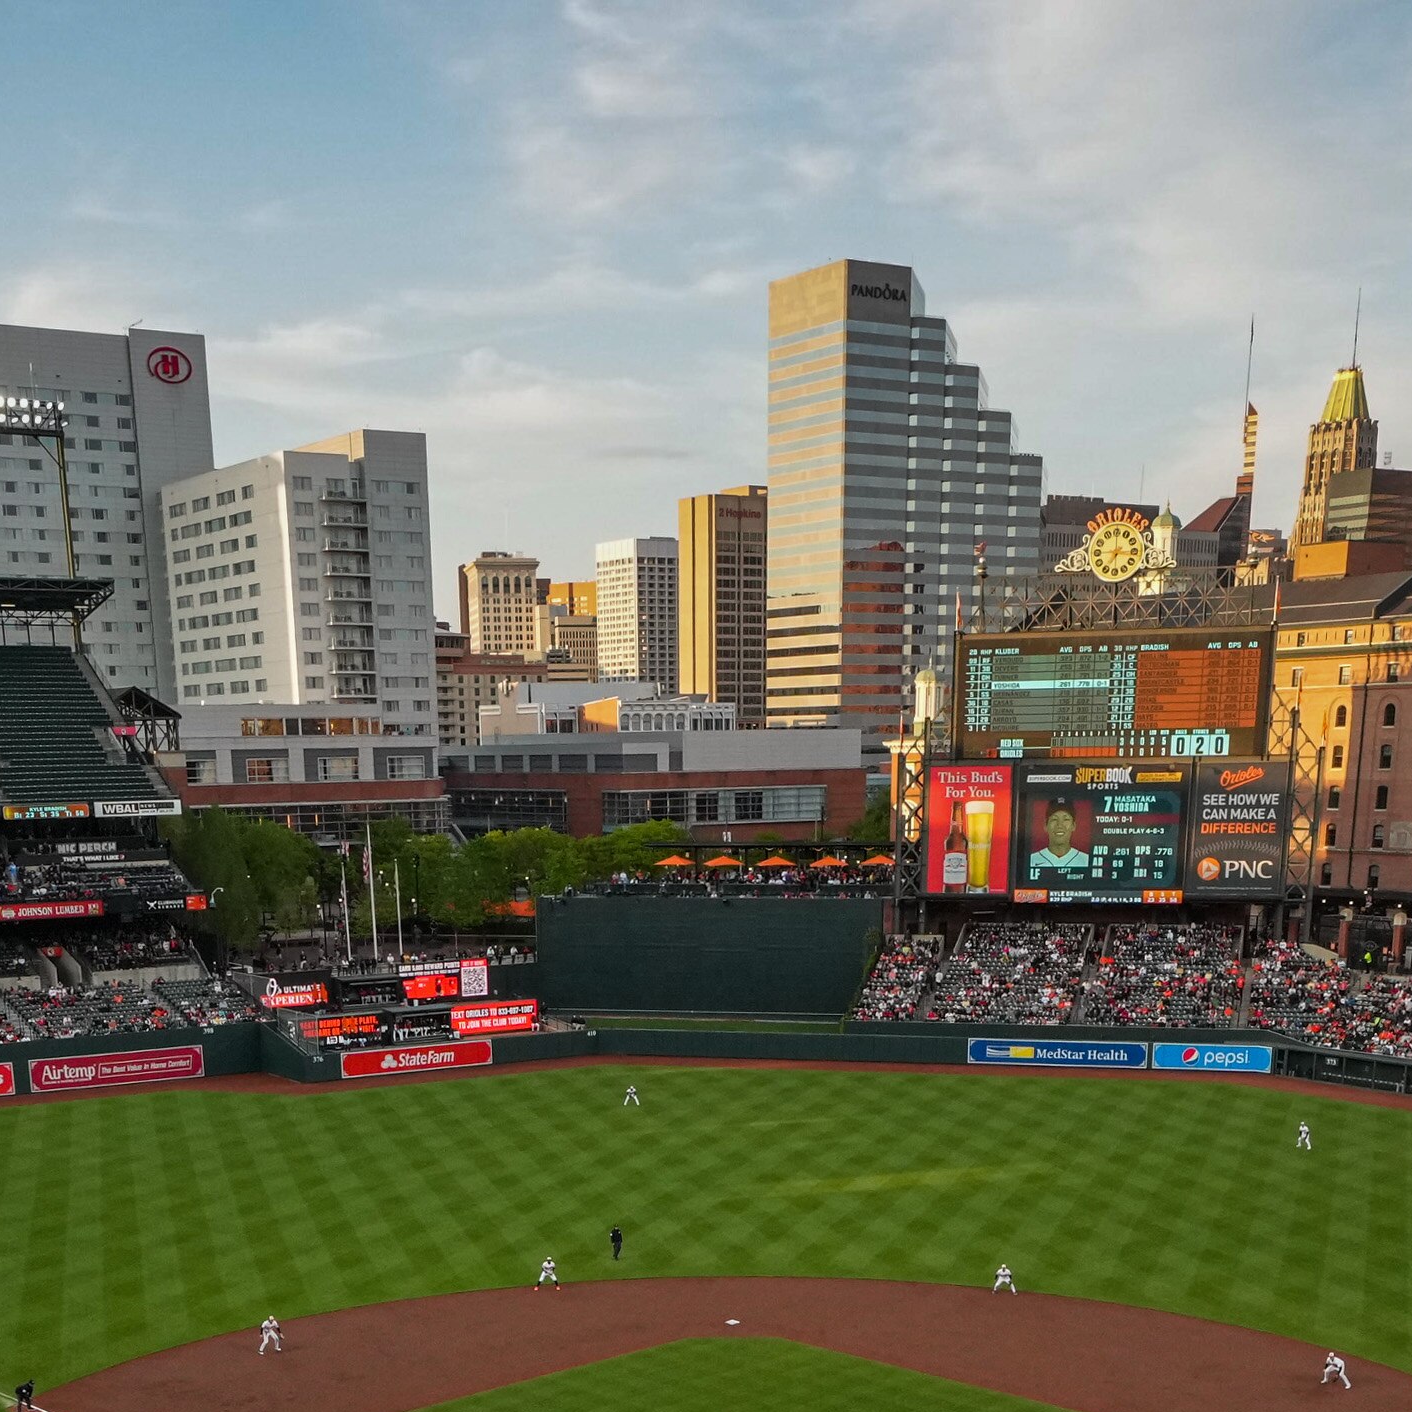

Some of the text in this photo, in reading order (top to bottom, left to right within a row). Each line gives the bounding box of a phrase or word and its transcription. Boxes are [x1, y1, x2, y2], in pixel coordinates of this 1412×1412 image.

[1087, 507, 1149, 533] ORIOLES
[1060, 646, 1073, 654] AVG
[1141, 641, 1221, 651] BRADISH AVG
[1175, 735, 1224, 755] 0 2 0
[1000, 750, 1023, 758] ORIOLES
[938, 770, 1003, 783] This Bud's
[1075, 766, 1133, 784] SUPERBOOK
[1220, 766, 1265, 790] Orioles
[945, 785, 995, 797] For You.
[1104, 795, 1156, 812] 7 MASATAKA
[1202, 793, 1280, 805] SEE HOW WE
[101, 803, 138, 815] WBAL
[1114, 803, 1149, 812] YOSHIDA
[1202, 808, 1276, 820] CAN MAKE A
[1200, 822, 1276, 834] DIFFERENCE
[78, 842, 117, 853] PERCH
[1093, 845, 1108, 855] AVG
[1135, 845, 1151, 855] OPS
[1030, 869, 1040, 880] LF
[1223, 860, 1273, 879] PNC
[17, 905, 85, 917] JOHNSON LUMBER
[444, 961, 460, 969] POINTS
[451, 1008, 489, 1019] TEXT ORIOLES
[458, 1016, 527, 1029] TO JOIN THE CLUB TODAY!
[398, 1050, 455, 1067] StateFarm
[1036, 1048, 1128, 1061] MedStar Health
[1204, 1049, 1249, 1067] pepsi
[127, 1064, 143, 1072] Value
[150, 1062, 167, 1070] Home
[167, 1059, 190, 1068] Comfort
[42, 1063, 96, 1081] Airtemp
